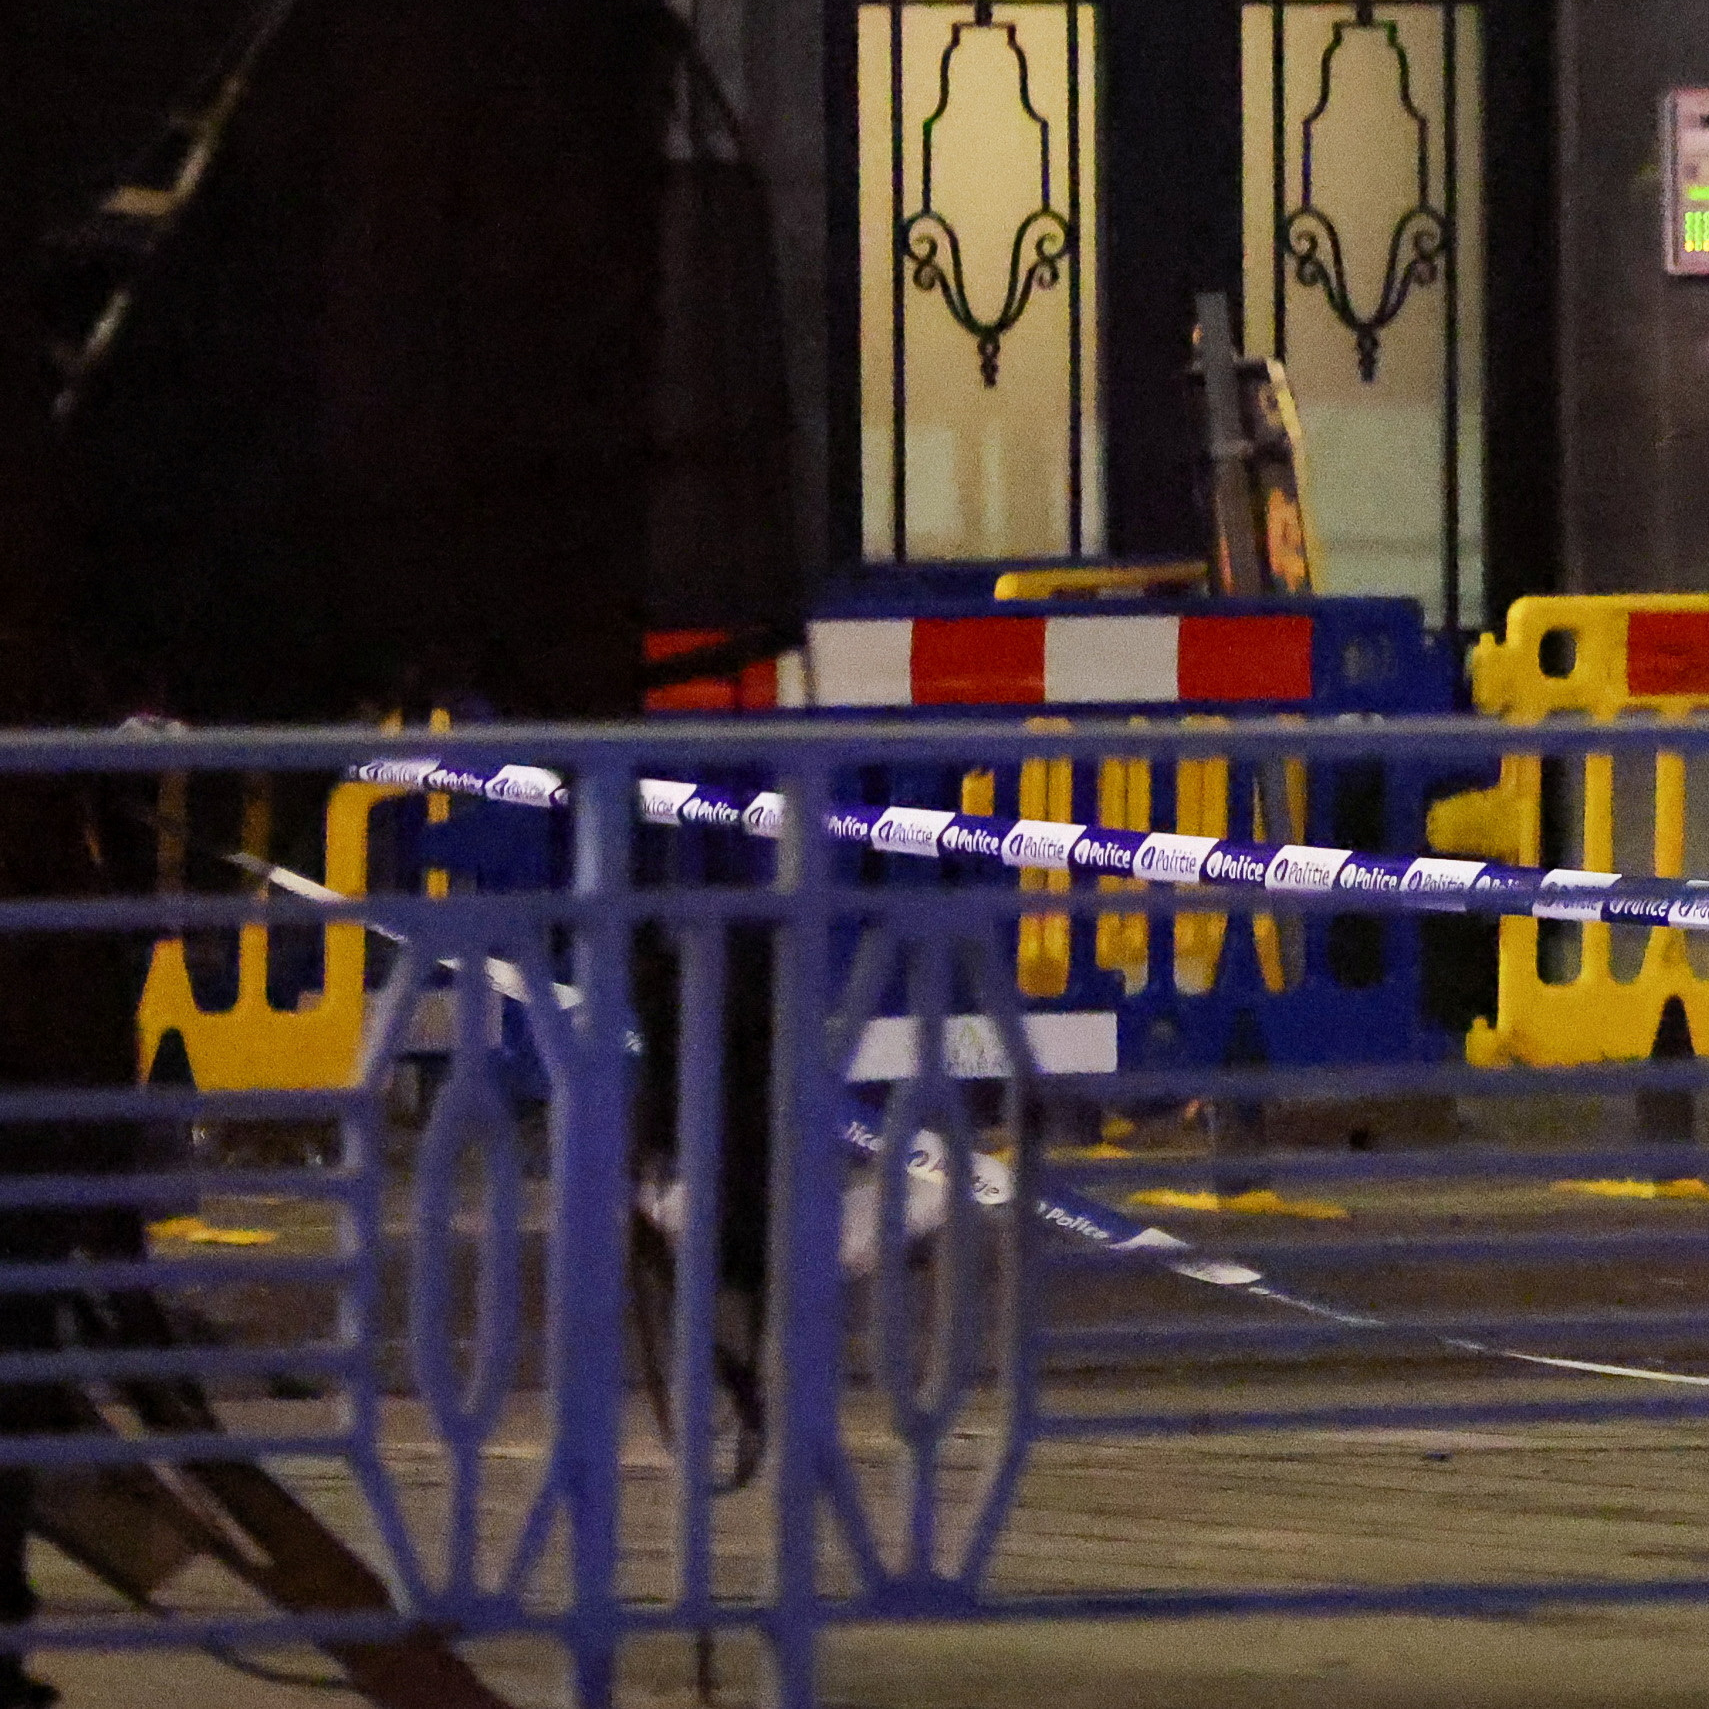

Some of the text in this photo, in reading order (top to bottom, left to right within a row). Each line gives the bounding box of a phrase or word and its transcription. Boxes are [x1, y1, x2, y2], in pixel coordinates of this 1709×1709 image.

[957, 828, 999, 855] Police
[1090, 841, 1131, 869] Police
[1155, 849, 1197, 874] Politie
[1221, 853, 1265, 882] Police
[1288, 862, 1331, 887] Politie
